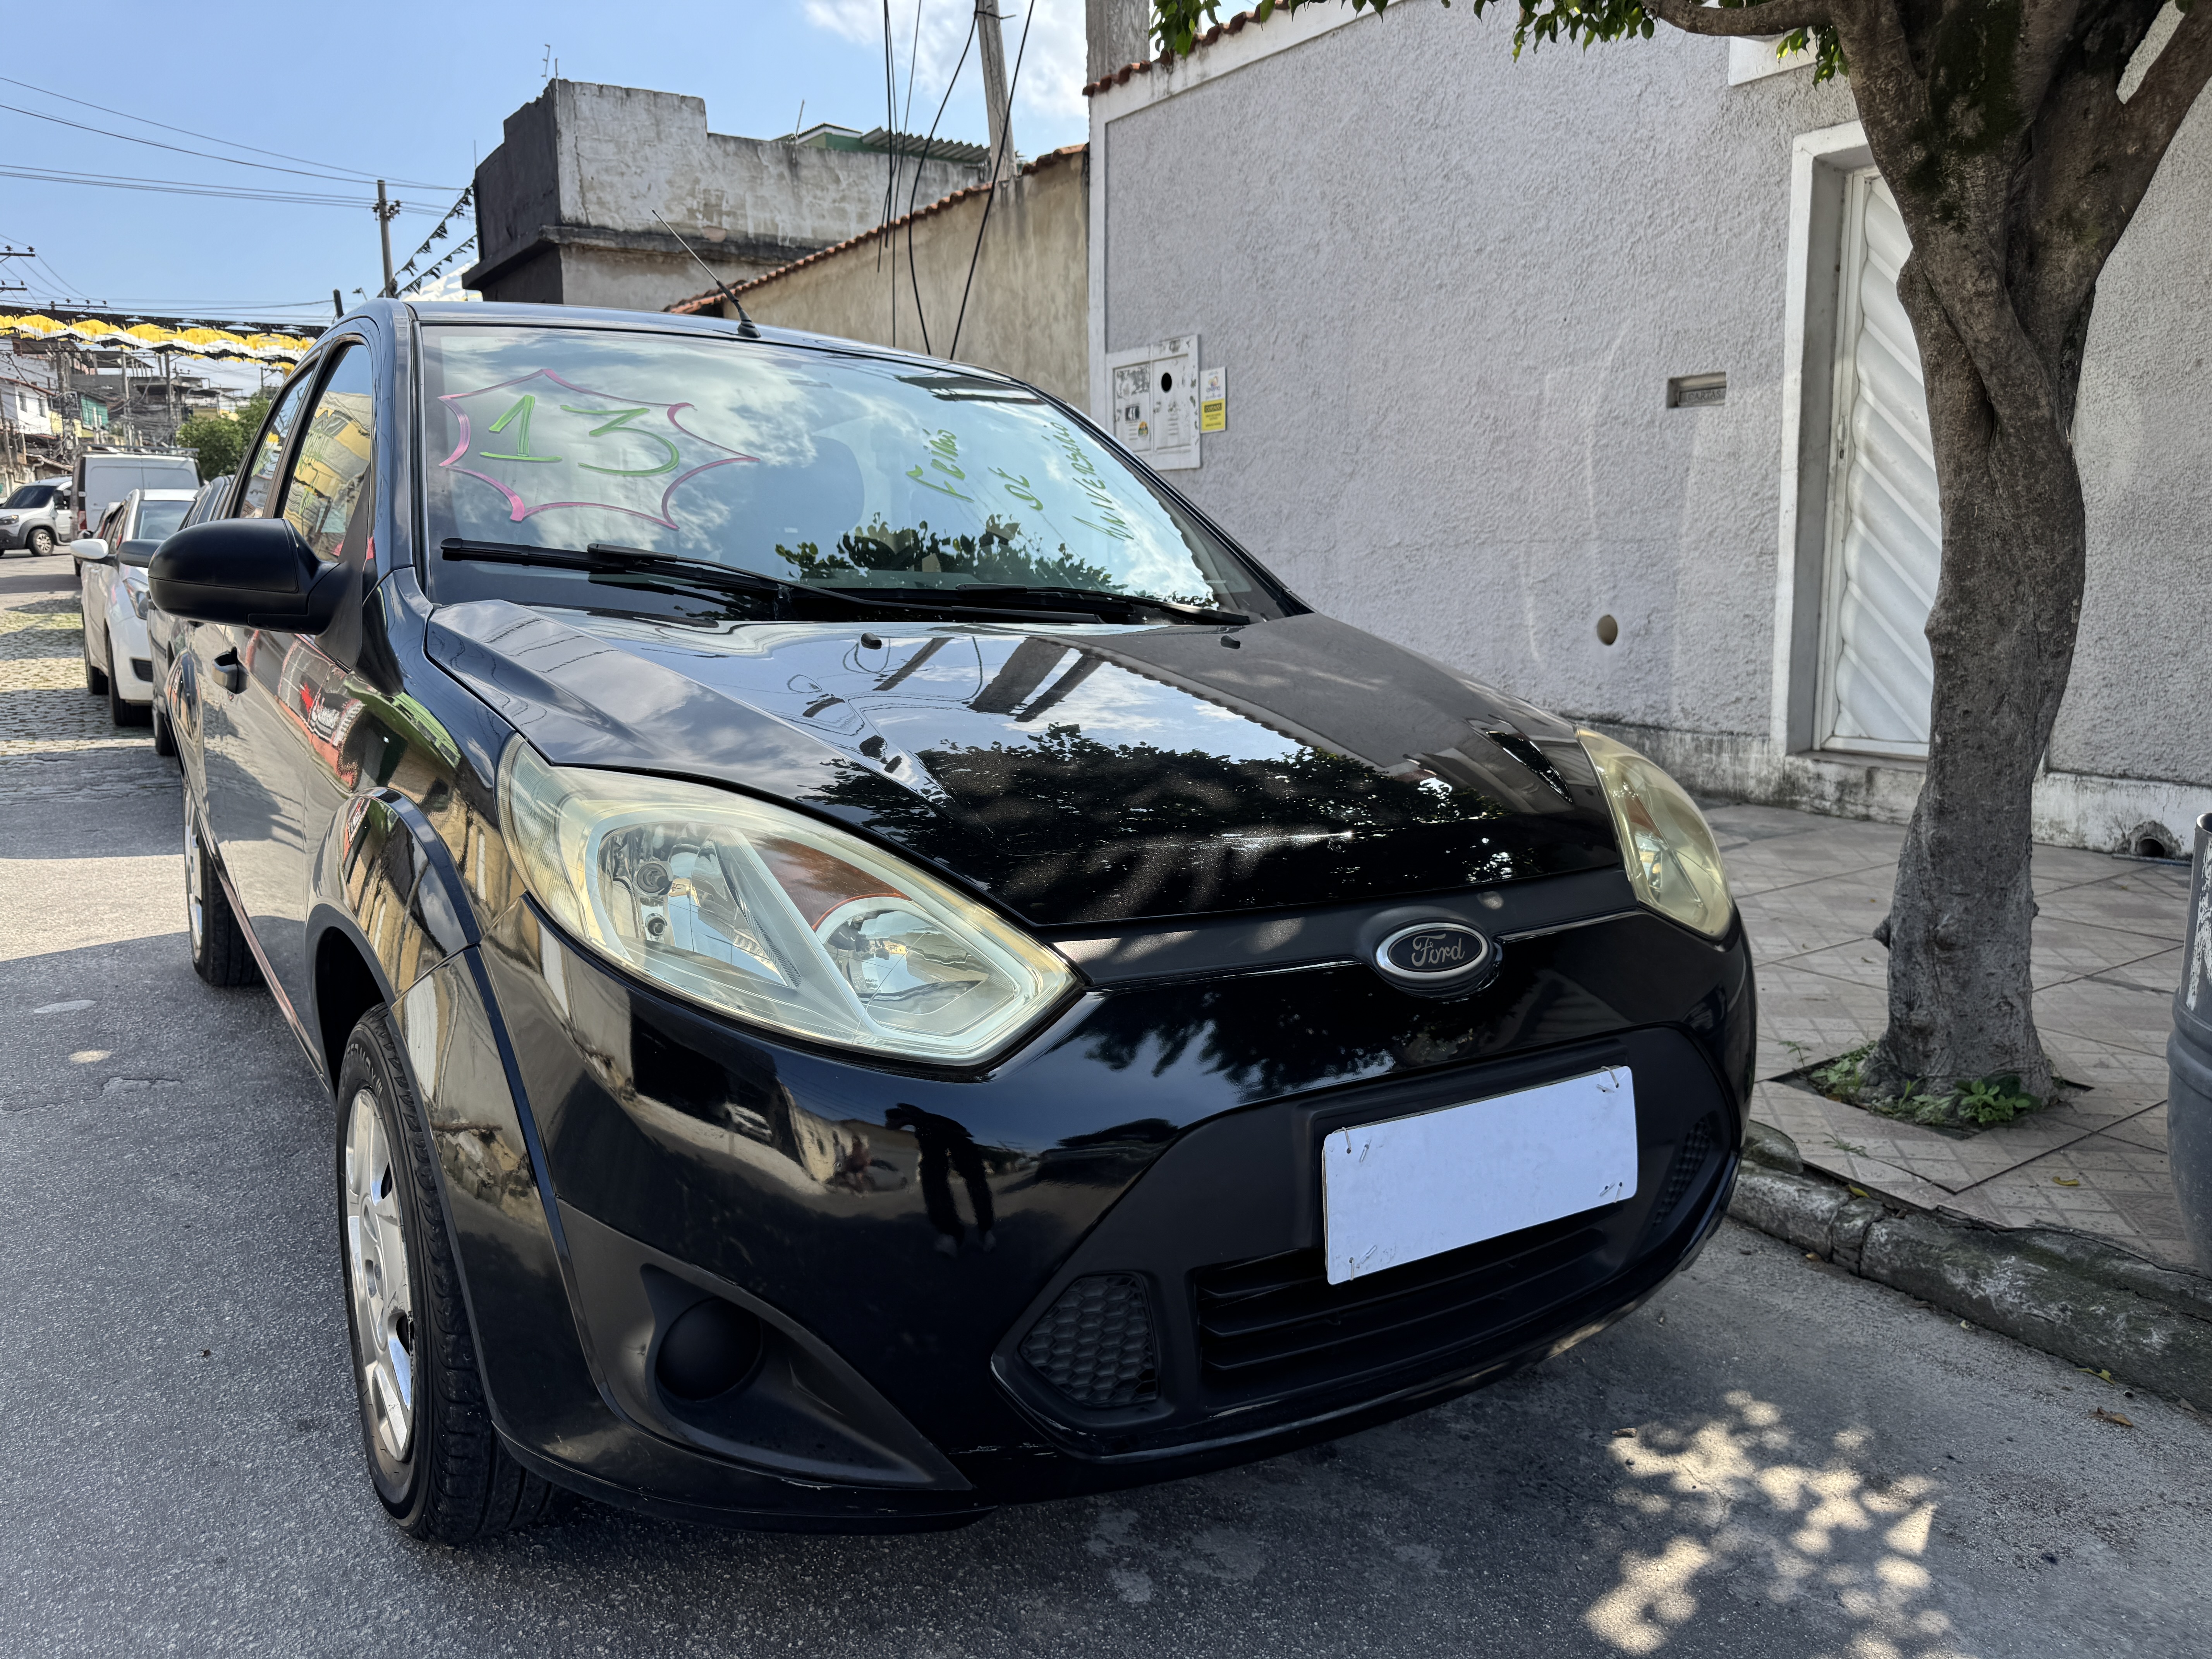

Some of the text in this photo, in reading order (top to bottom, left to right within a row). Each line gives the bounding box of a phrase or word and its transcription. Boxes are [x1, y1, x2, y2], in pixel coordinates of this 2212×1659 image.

[1688, 390, 1721, 401] CARTAS
[479, 395, 680, 477] 13
[1411, 933, 1465, 967] Ford
